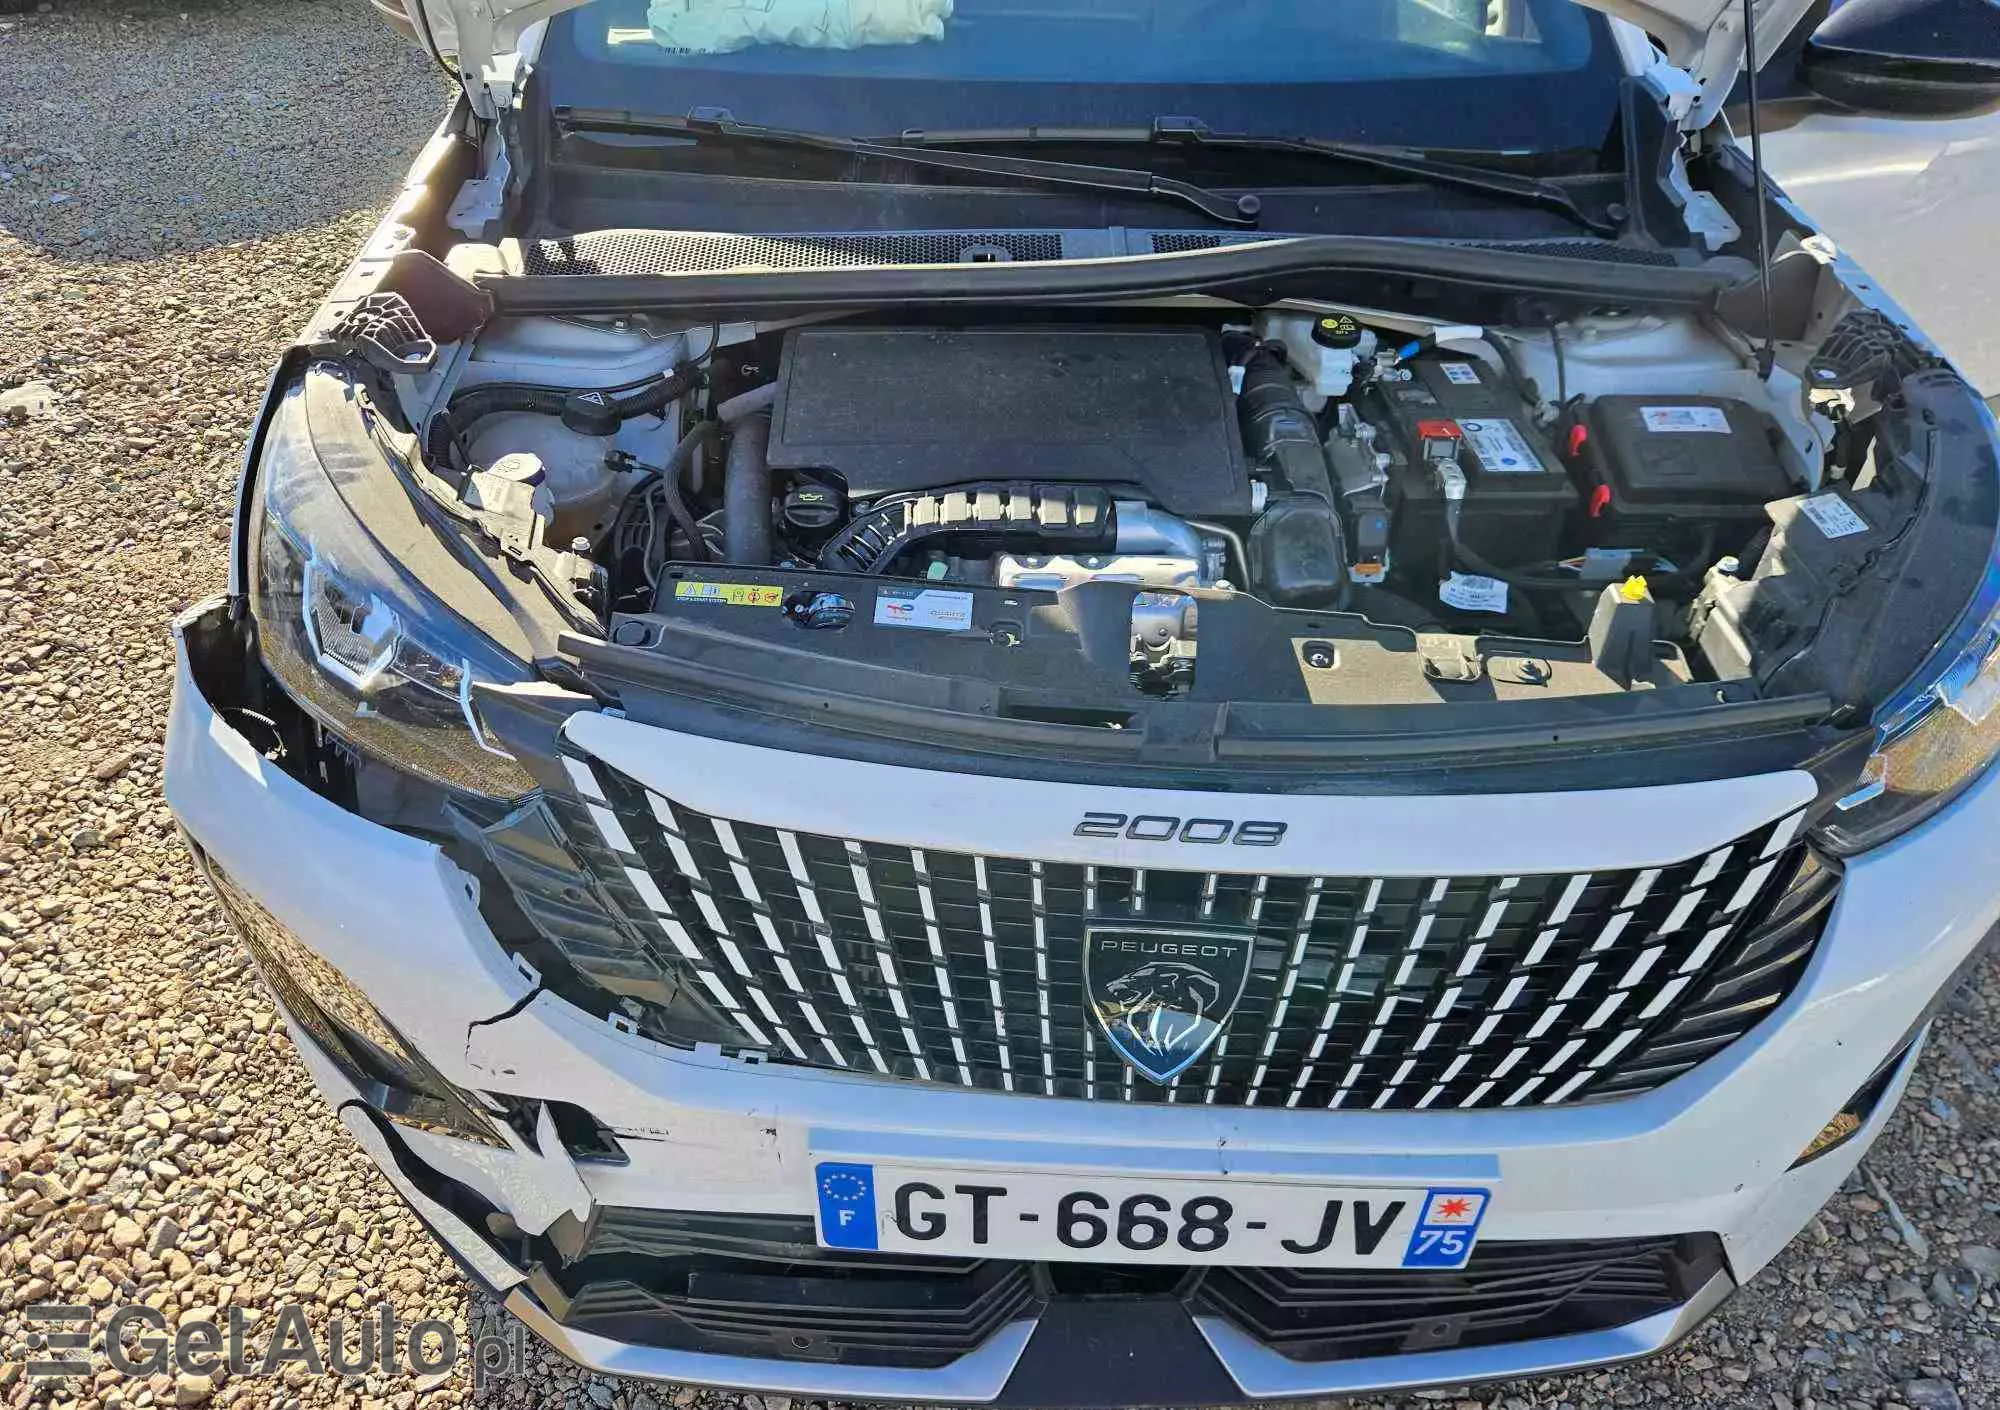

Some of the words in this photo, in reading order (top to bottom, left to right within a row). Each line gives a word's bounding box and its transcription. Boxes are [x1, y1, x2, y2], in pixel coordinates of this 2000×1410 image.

[1073, 811, 1288, 847] 2008
[1100, 940, 1238, 959] PEUGEOT
[839, 1209, 855, 1226] F
[894, 1181, 1407, 1256] GT-668-JV
[1414, 1230, 1467, 1255] 75
